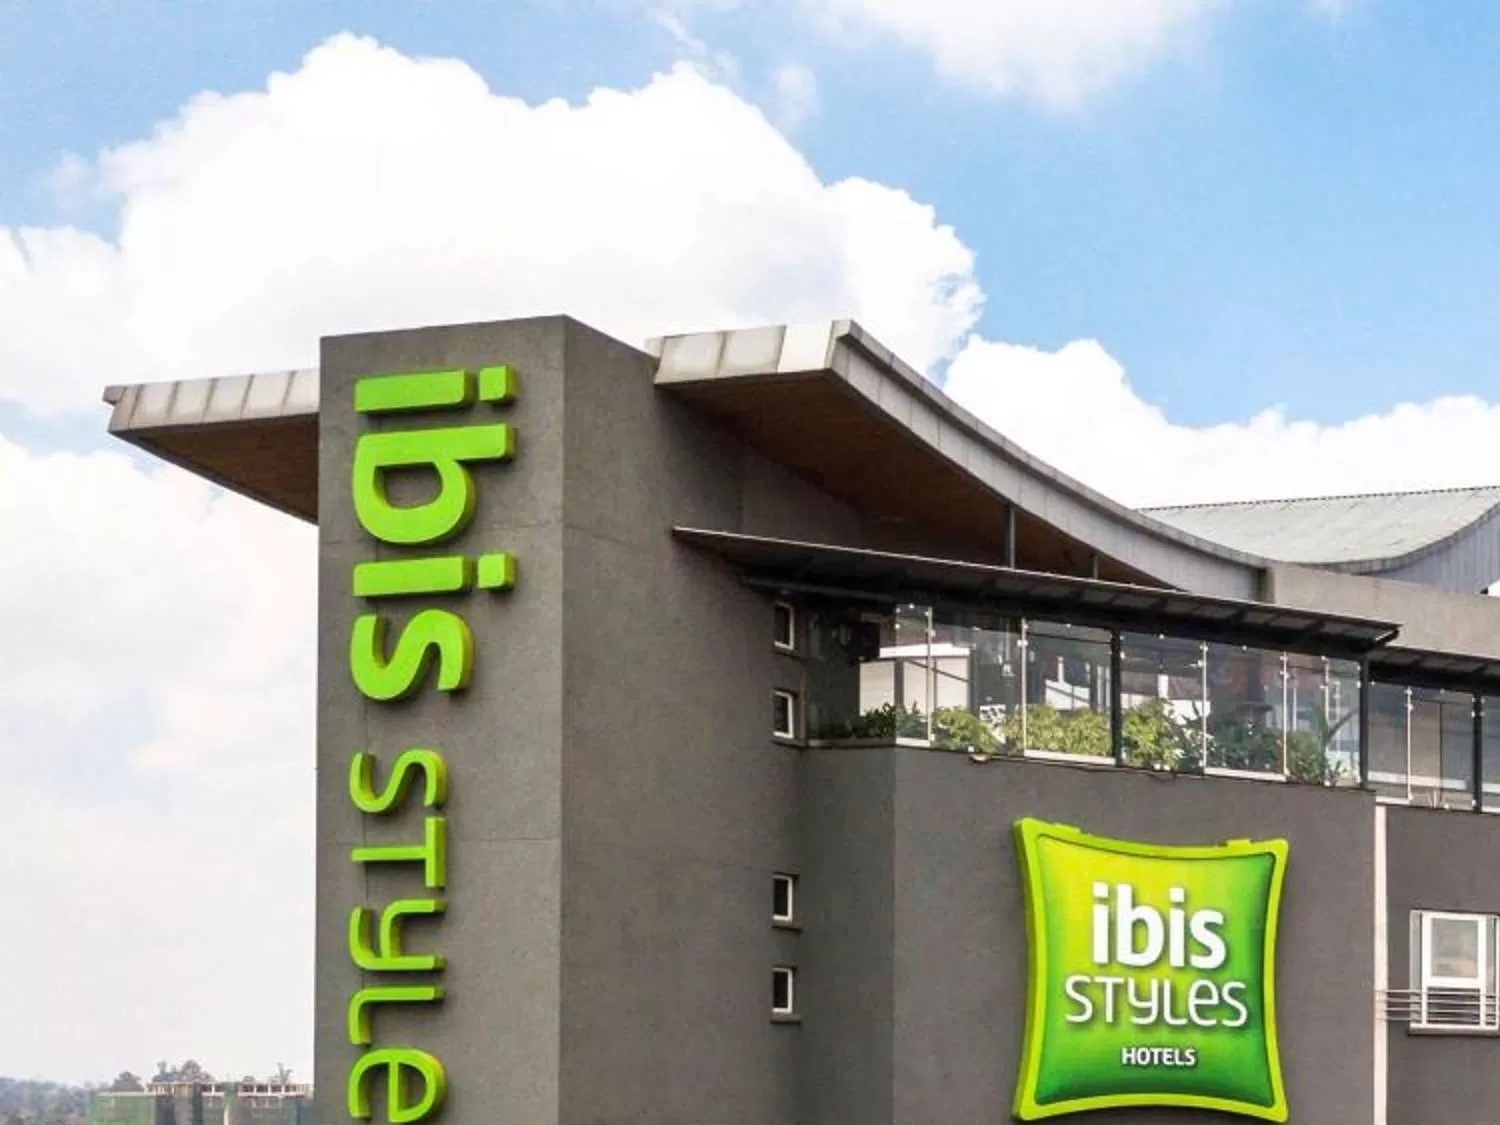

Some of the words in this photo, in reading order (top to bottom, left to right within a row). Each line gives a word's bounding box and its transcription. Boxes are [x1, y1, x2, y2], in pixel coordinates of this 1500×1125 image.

[350, 364, 516, 701] ibis
[1091, 881, 1227, 969] ibis
[1121, 1047, 1196, 1067] HOTELS
